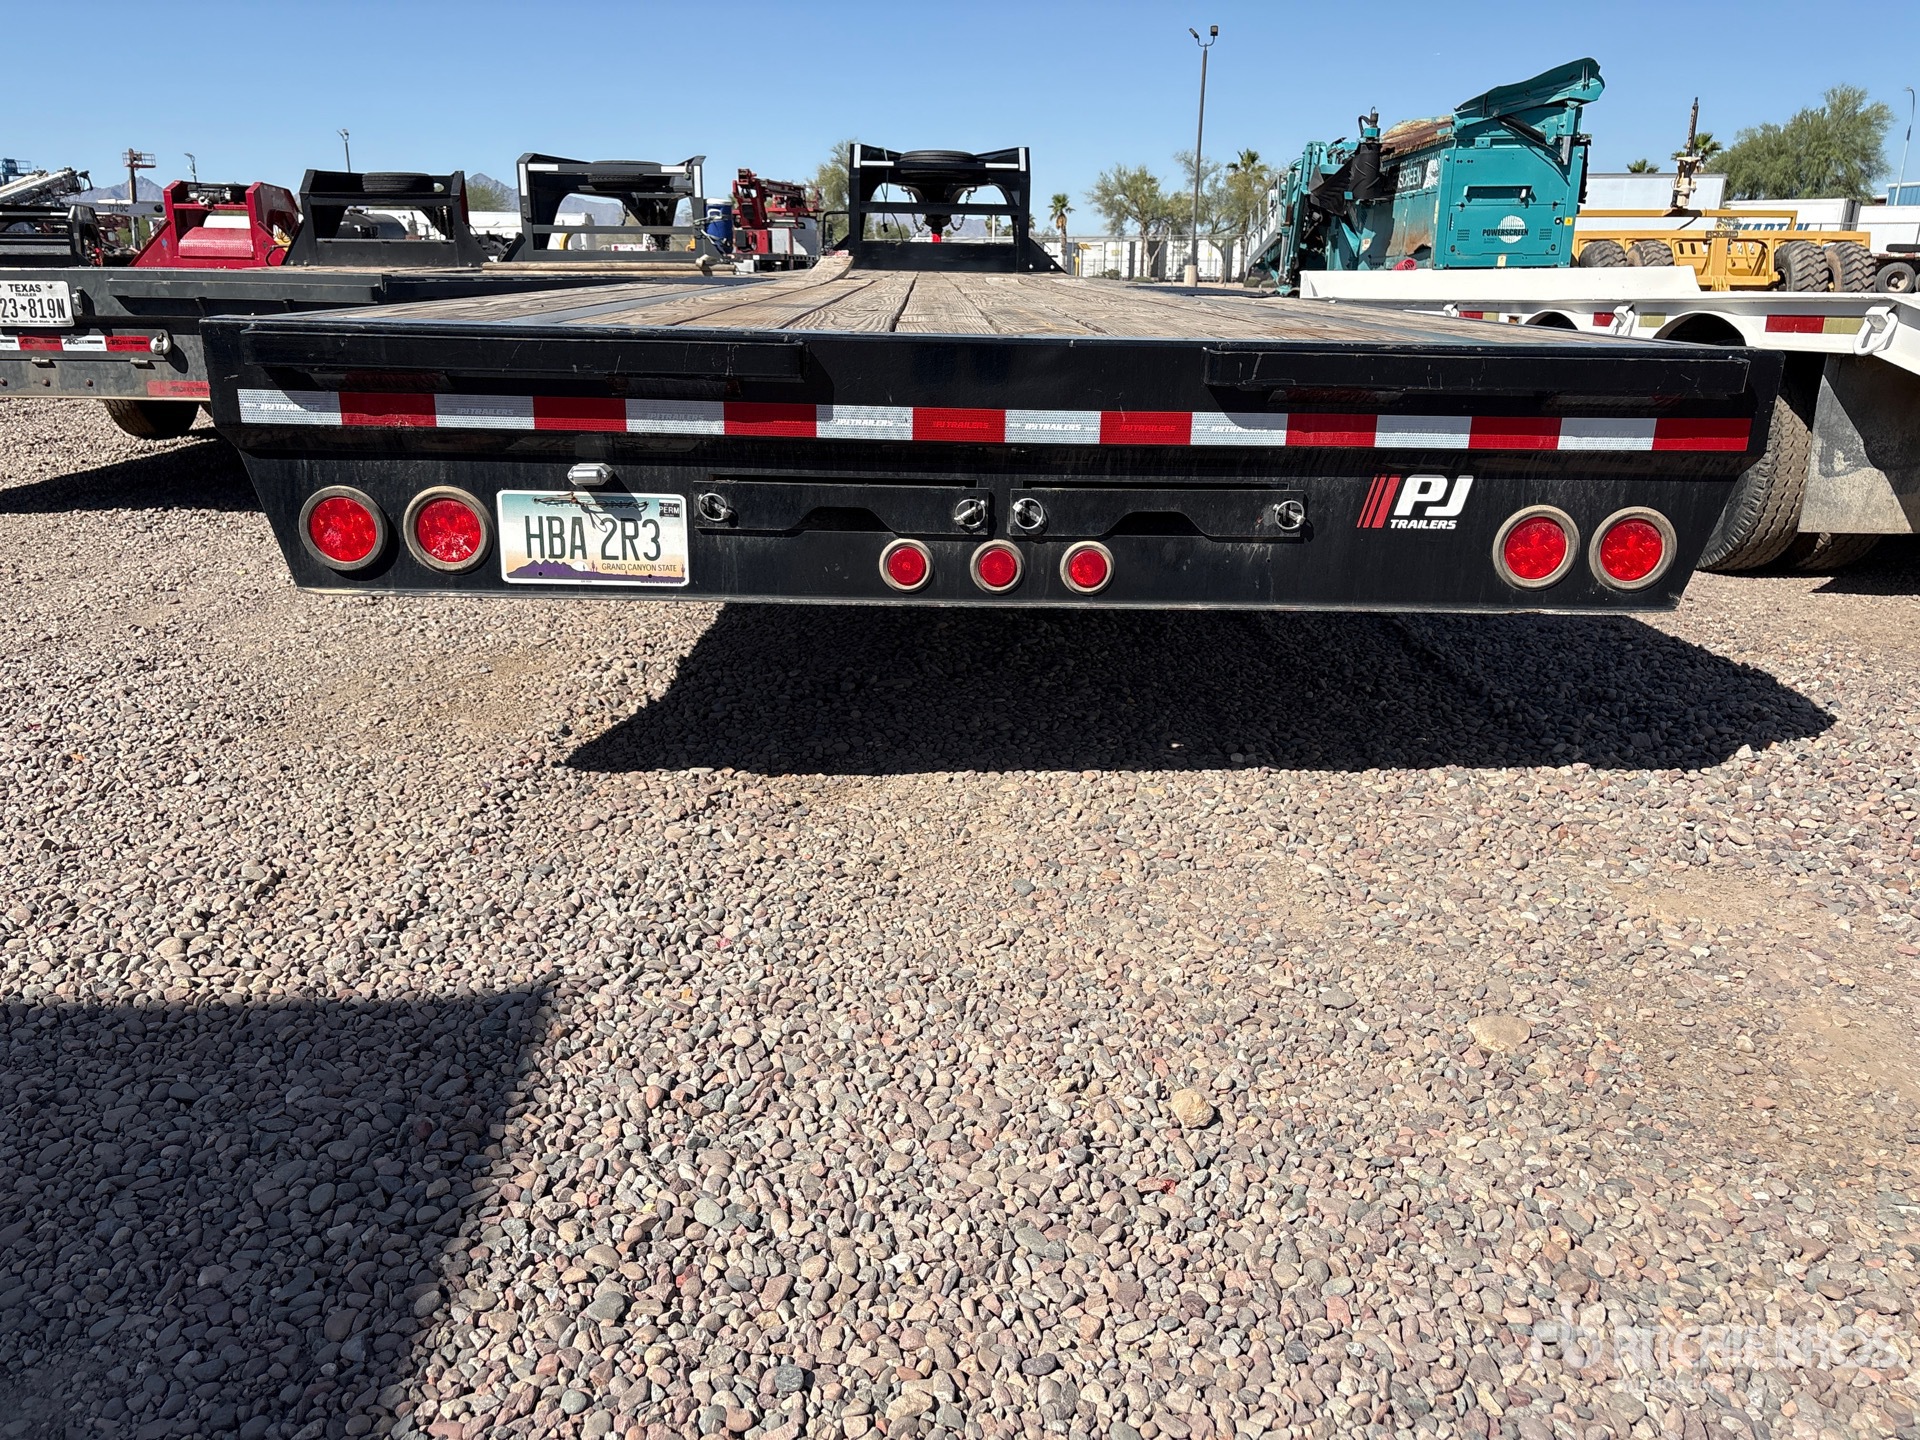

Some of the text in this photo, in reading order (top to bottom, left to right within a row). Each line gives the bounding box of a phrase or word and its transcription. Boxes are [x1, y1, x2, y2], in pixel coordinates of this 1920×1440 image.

[1482, 228, 1529, 237] POWERSCREEN
[8, 283, 42, 293] TEXAS
[1393, 474, 1474, 516] PJ
[658, 505, 680, 514] PERM
[1390, 519, 1458, 530] TRAILERS
[525, 516, 661, 562] HBA 2R3
[602, 562, 677, 572] GRAND CANYON STATE
